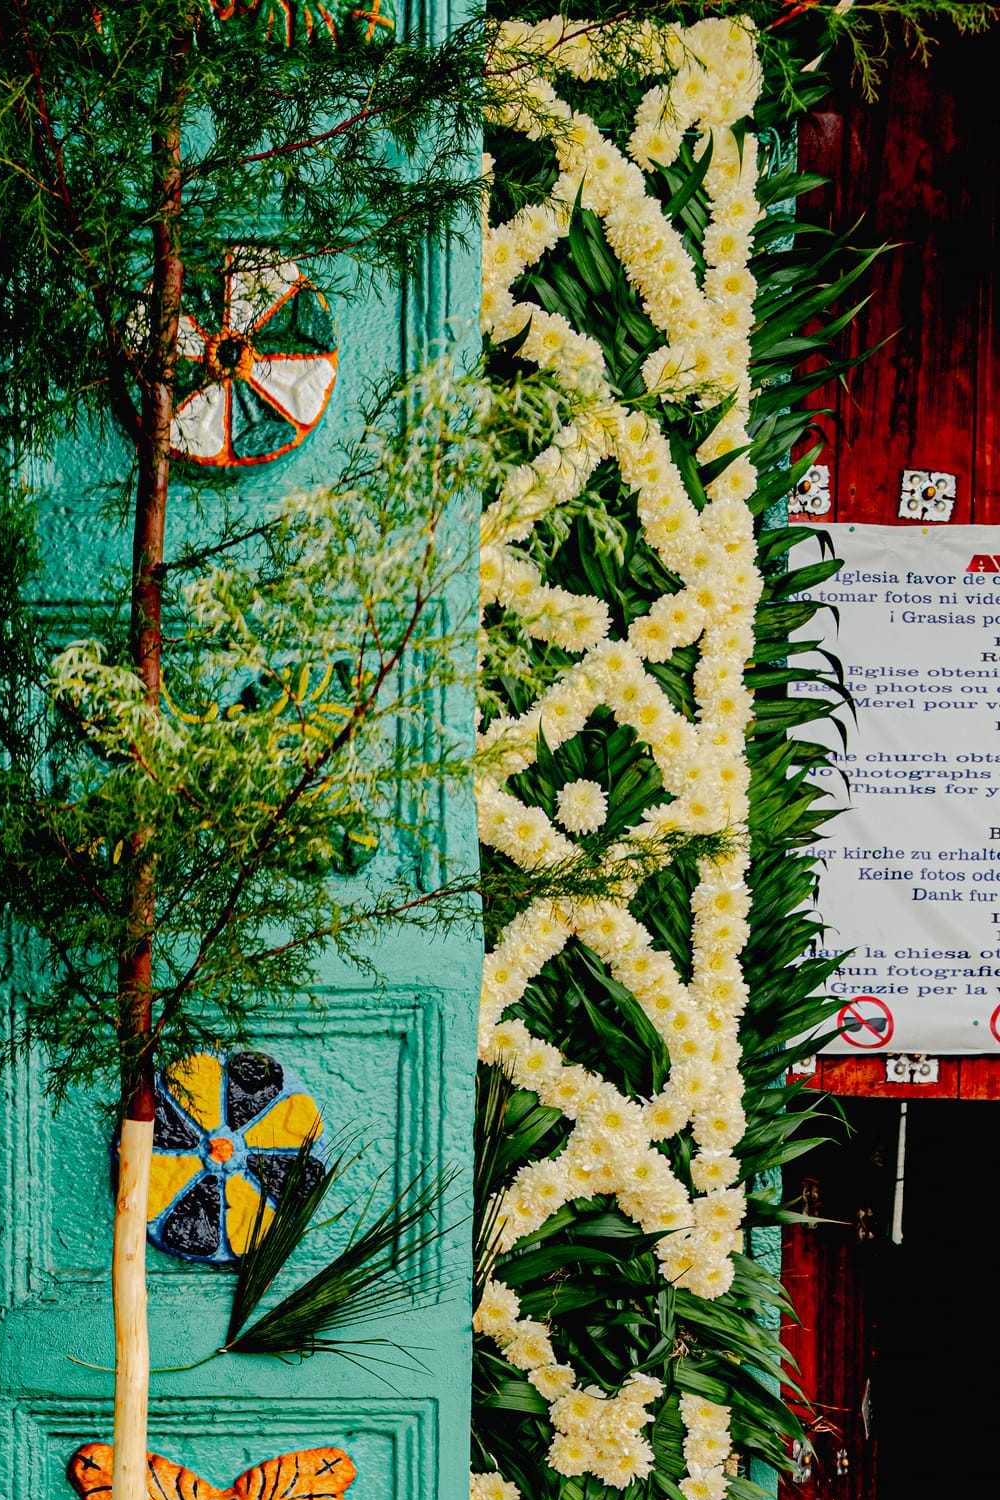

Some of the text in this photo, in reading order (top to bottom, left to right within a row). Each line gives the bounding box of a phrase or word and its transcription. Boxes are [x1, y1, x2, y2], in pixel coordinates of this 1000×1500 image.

[833, 570, 899, 585] Iglesia
[906, 571, 956, 584] favor
[963, 573, 985, 585] de
[819, 590, 878, 602] tomar
[885, 591, 932, 604] fotos
[939, 592, 958, 604] ni
[902, 610, 976, 624] Grasias
[847, 665, 919, 679] Eglise
[793, 682, 832, 692] Pas
[875, 683, 953, 694] photos
[960, 685, 989, 694] ou
[923, 701, 978, 712] pour
[865, 752, 948, 763] church
[848, 783, 936, 795] Thanks
[945, 783, 979, 795] for
[805, 846, 837, 859] der
[843, 846, 905, 860] kirche
[911, 849, 932, 860] zu
[858, 867, 914, 880] Keine
[920, 867, 966, 881] fotos
[911, 887, 998, 902] Dank fur
[865, 946, 887, 958] la
[894, 947, 971, 959] chiesa
[830, 982, 909, 994] Grazie
[917, 985, 957, 998] per
[965, 983, 988, 995] la
